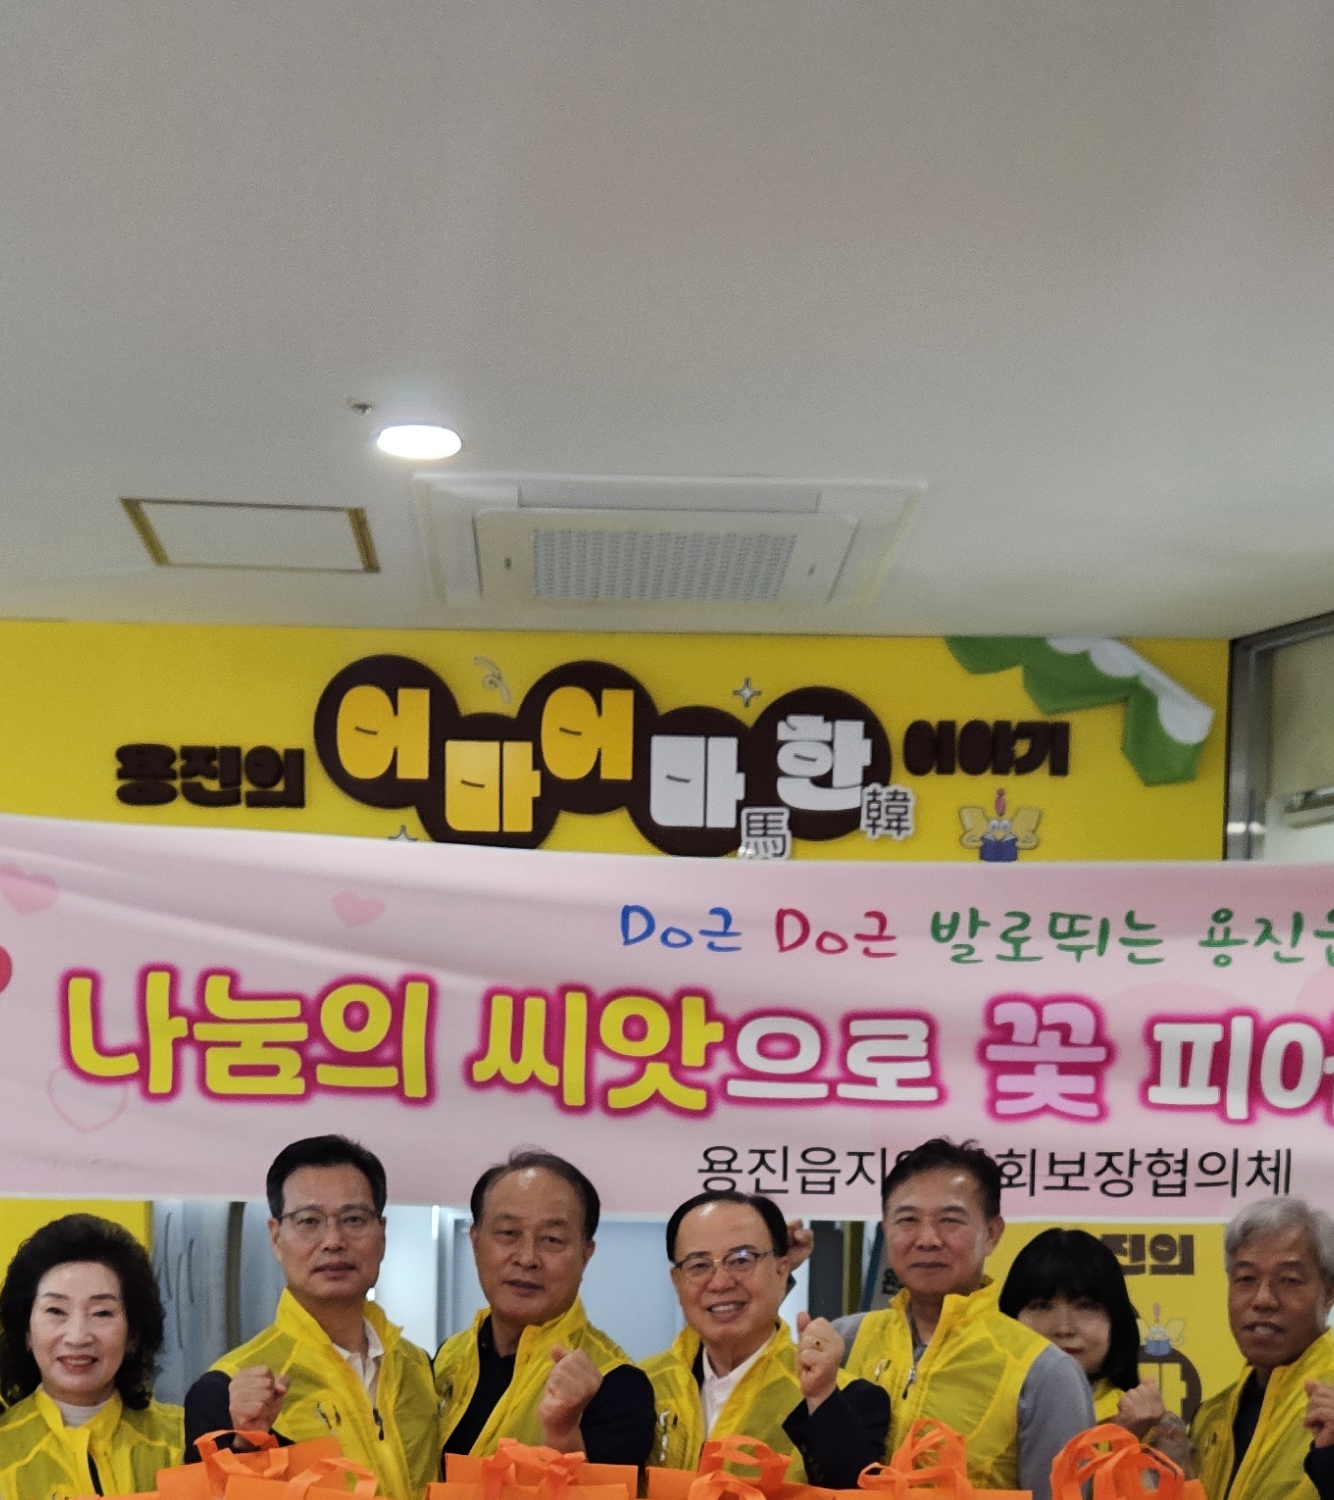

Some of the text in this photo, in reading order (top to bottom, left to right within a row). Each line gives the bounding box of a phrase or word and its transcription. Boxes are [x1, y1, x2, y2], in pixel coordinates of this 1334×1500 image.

[116, 744, 305, 808] 용진의
[903, 720, 1071, 777] 이야기
[743, 810, 789, 859] 馬
[867, 787, 911, 837] 韓
[622, 903, 743, 953] Do근
[777, 906, 898, 958] Do근
[930, 906, 1165, 966] 발로뛰는
[64, 972, 434, 1104] 나눔의
[472, 990, 941, 1113] 씨앗으로
[986, 1000, 1109, 1119] 꽃
[696, 1145, 1293, 1198] 용진읍지회보장협의체
